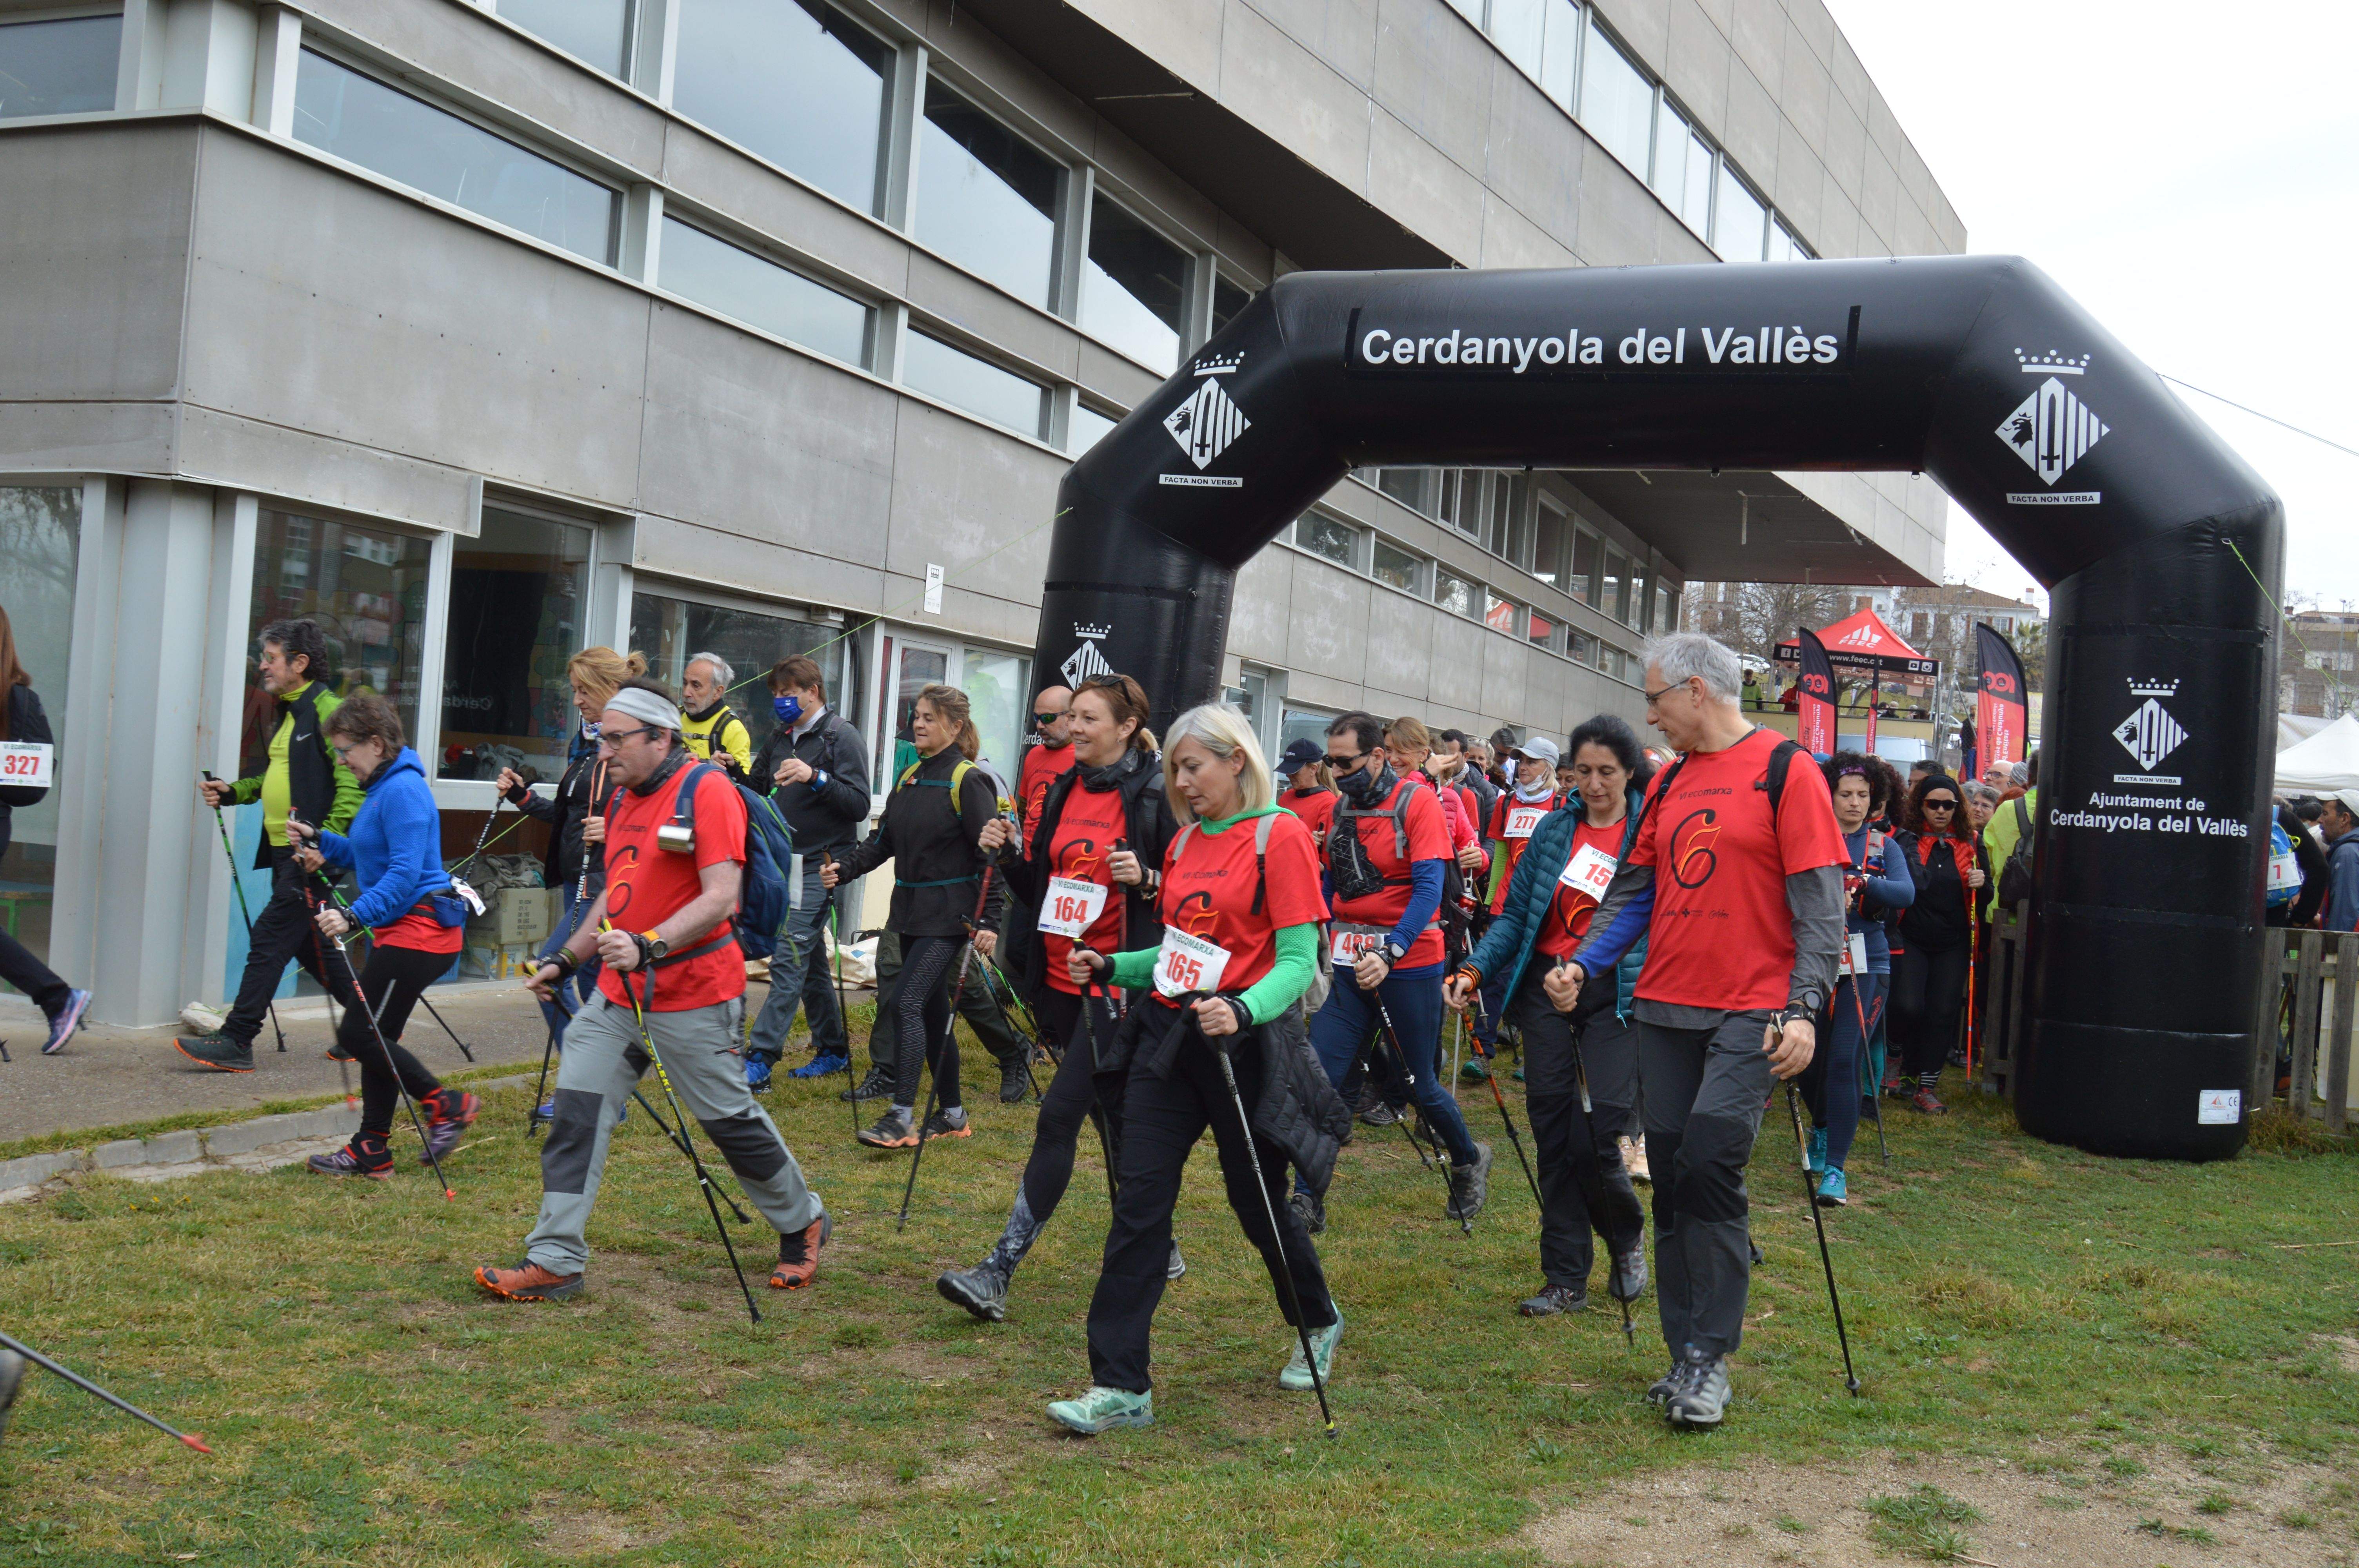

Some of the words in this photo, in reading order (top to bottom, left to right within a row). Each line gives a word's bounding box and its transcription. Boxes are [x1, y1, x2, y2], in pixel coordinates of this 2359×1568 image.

[1362, 329, 1603, 374] Cerdanyola
[1618, 328, 1685, 364] del
[1701, 326, 1838, 364] Vallès
[1838, 639, 1876, 648] FEEC
[1829, 655, 1883, 666] www.feec.ct
[1022, 731, 1042, 745] Cerda
[4, 754, 40, 775] 327
[1688, 788, 1732, 797] ecomarxa
[2088, 792, 2182, 810] Ajuntament
[2186, 797, 2205, 811] de
[1514, 815, 1536, 829] 277
[2050, 809, 2151, 833] Cerdanyola
[2157, 814, 2190, 833] del
[2197, 817, 2248, 837] Vallès
[1599, 853, 1618, 866] ECOM
[1585, 863, 1613, 887] 15
[1058, 880, 1063, 888] VI
[1063, 881, 1094, 893] ECOMARXA
[1054, 895, 1089, 924] 164
[1177, 934, 1214, 957] ECOMARXA
[1167, 951, 1204, 991] 165
[1380, 1006, 1392, 1027] LEKI
[656, 1062, 672, 1092] LEKI
[1245, 1137, 1259, 1165] newfeel
